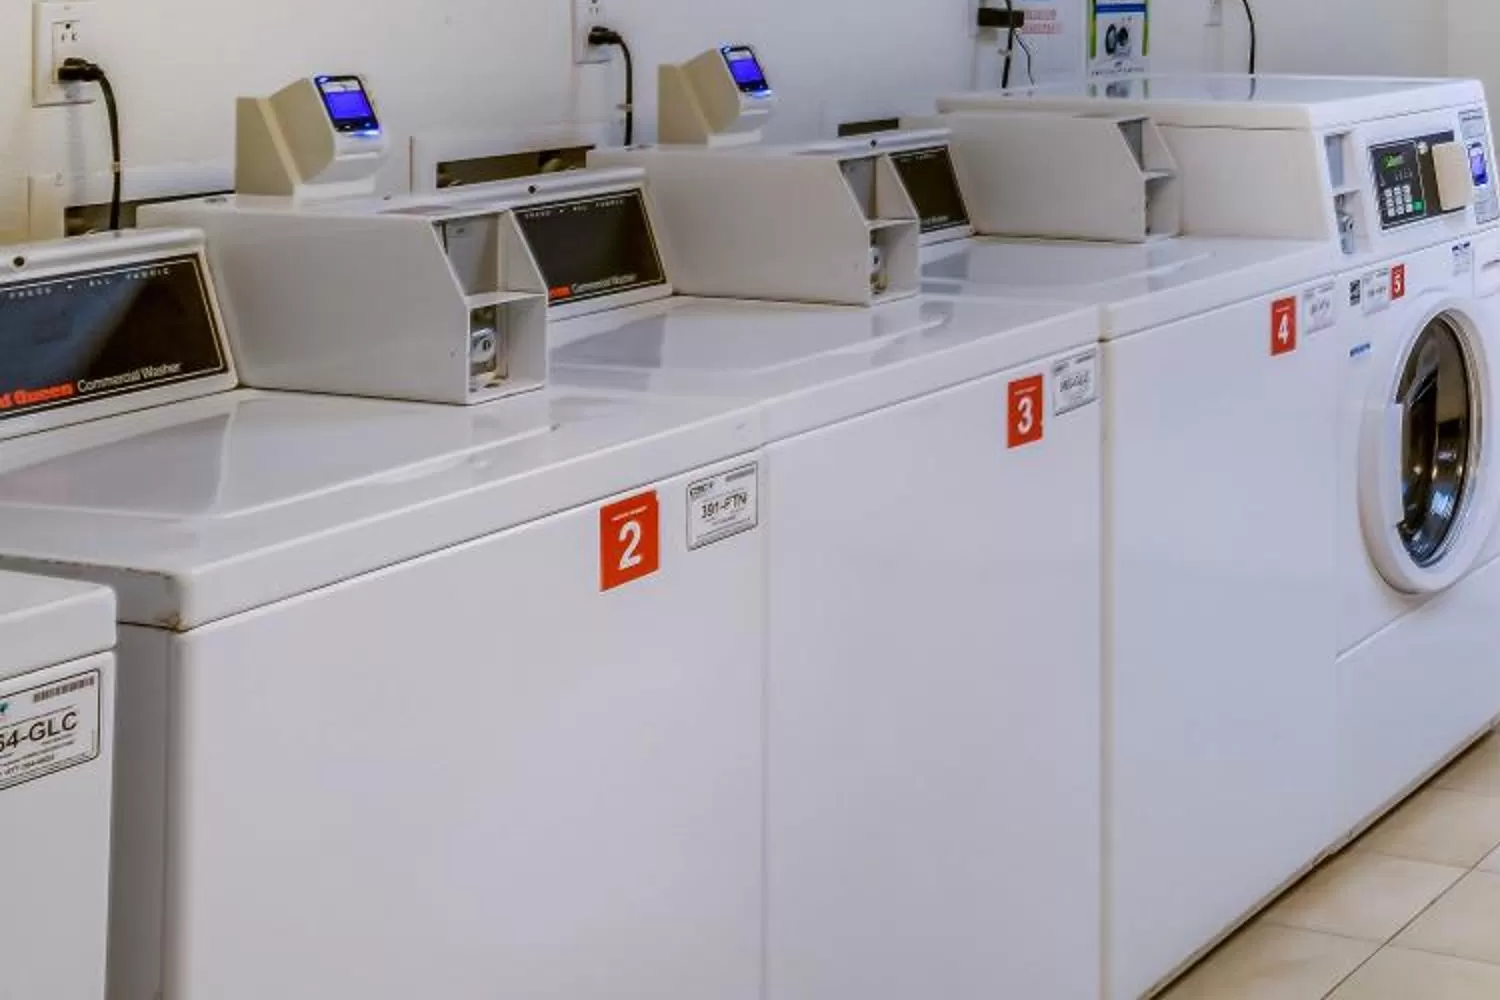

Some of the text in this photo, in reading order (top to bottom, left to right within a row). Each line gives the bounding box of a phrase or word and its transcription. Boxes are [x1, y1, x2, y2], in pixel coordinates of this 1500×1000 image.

[1395, 273, 1402, 293] 5
[1277, 312, 1289, 345] 4
[77, 369, 141, 393] Commercial
[141, 363, 182, 379] Washer
[1017, 395, 1033, 434] 3
[618, 520, 643, 571] 2
